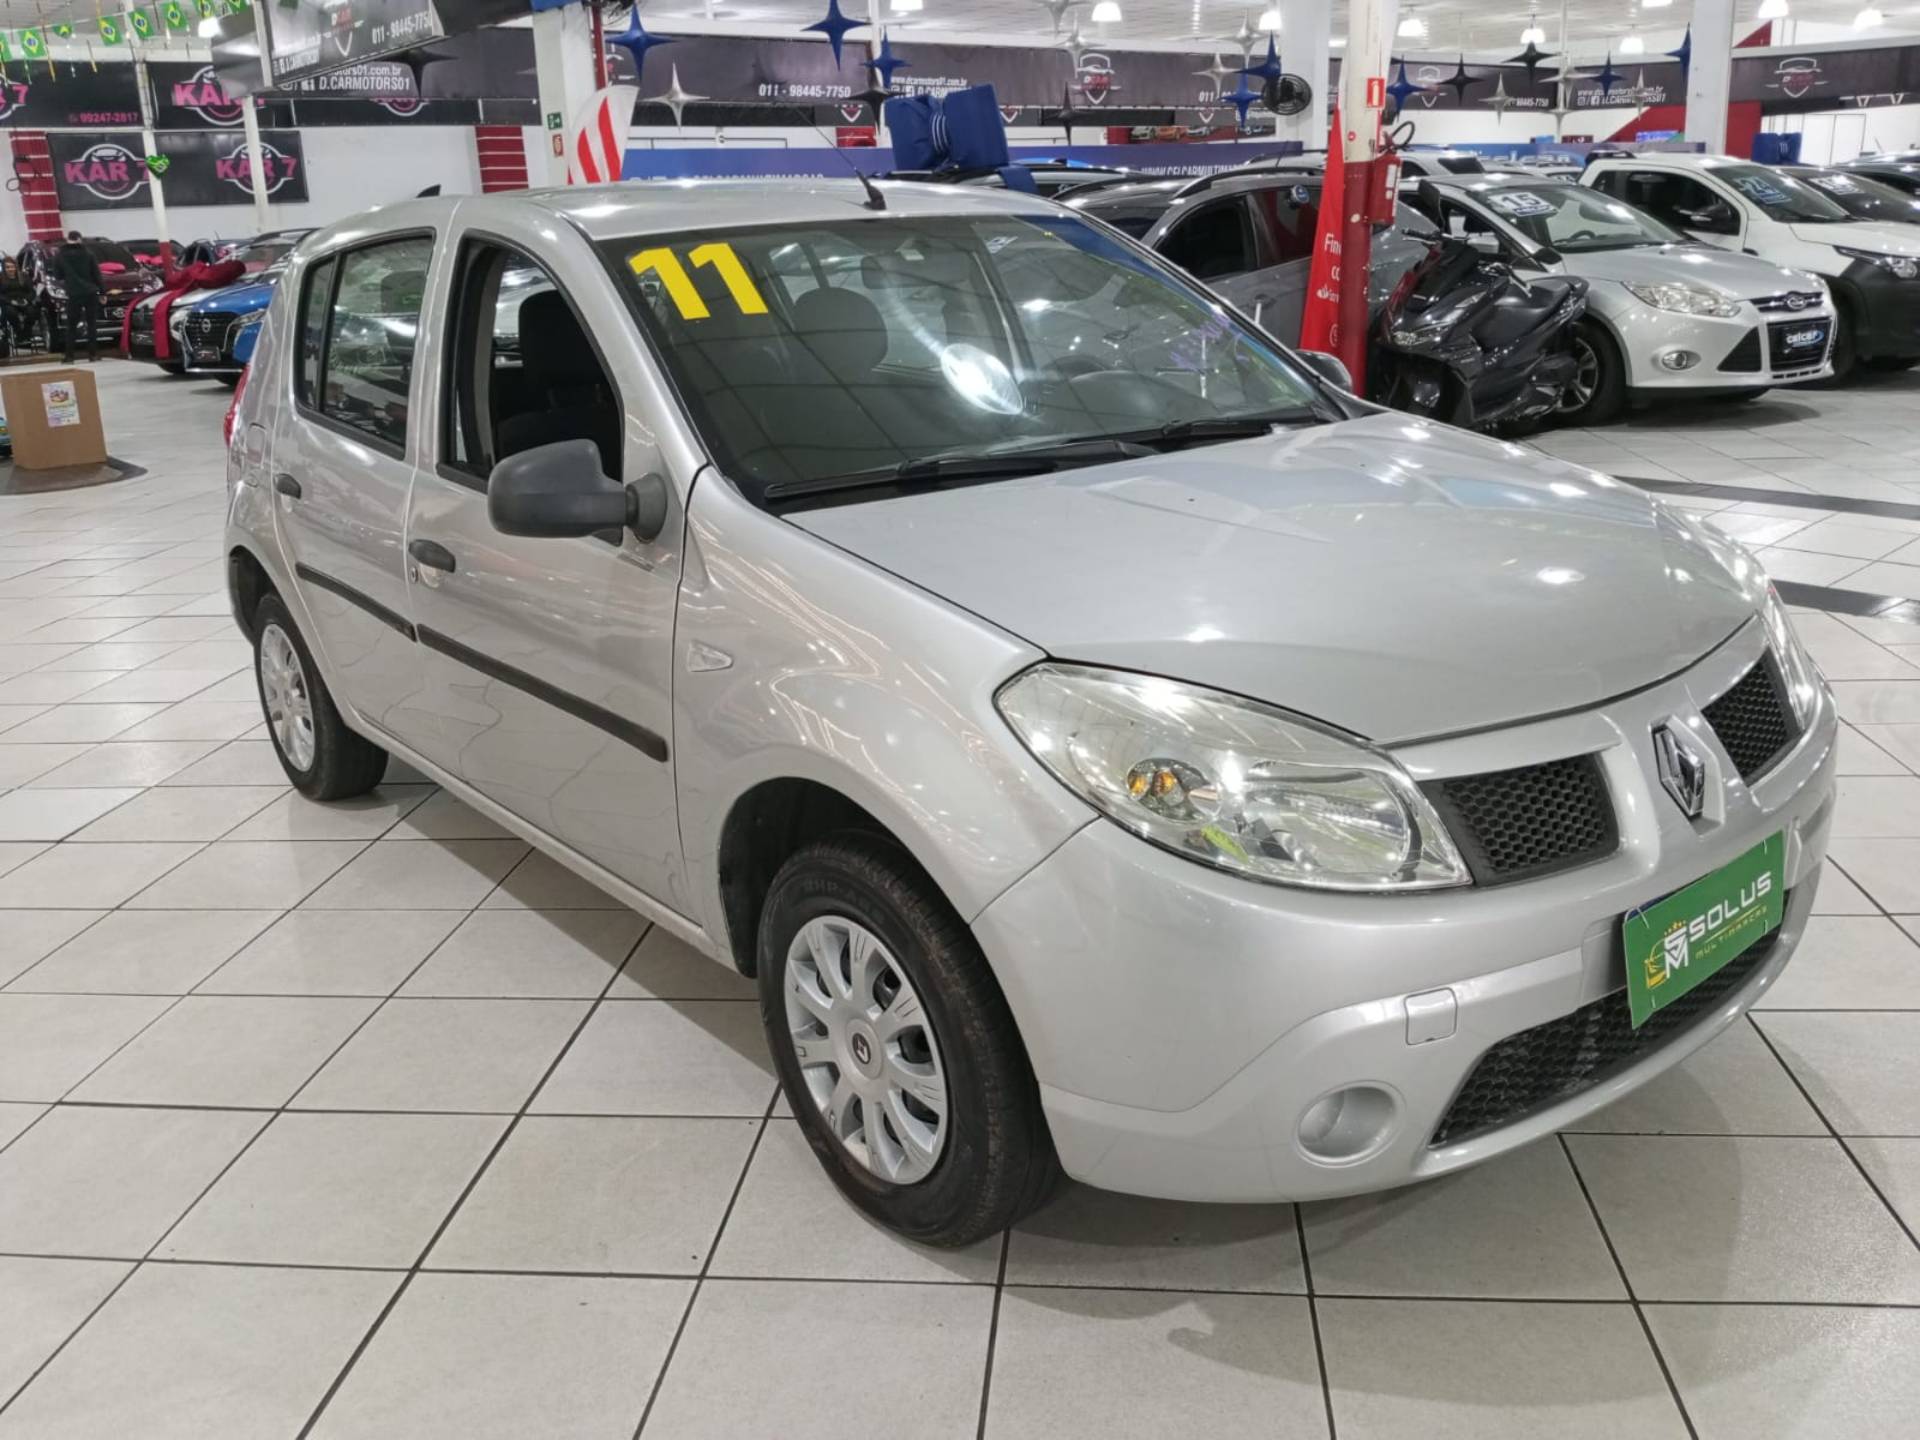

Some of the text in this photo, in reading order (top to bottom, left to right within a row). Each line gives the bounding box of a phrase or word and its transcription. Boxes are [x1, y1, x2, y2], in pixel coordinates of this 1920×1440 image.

[319, 77, 410, 91] D.CARMOTORS01
[758, 84, 779, 97] 011
[789, 84, 852, 98] 98445-7750
[64, 160, 130, 183] KAR
[628, 242, 769, 320] 11
[1689, 871, 1772, 943] SOLUS
